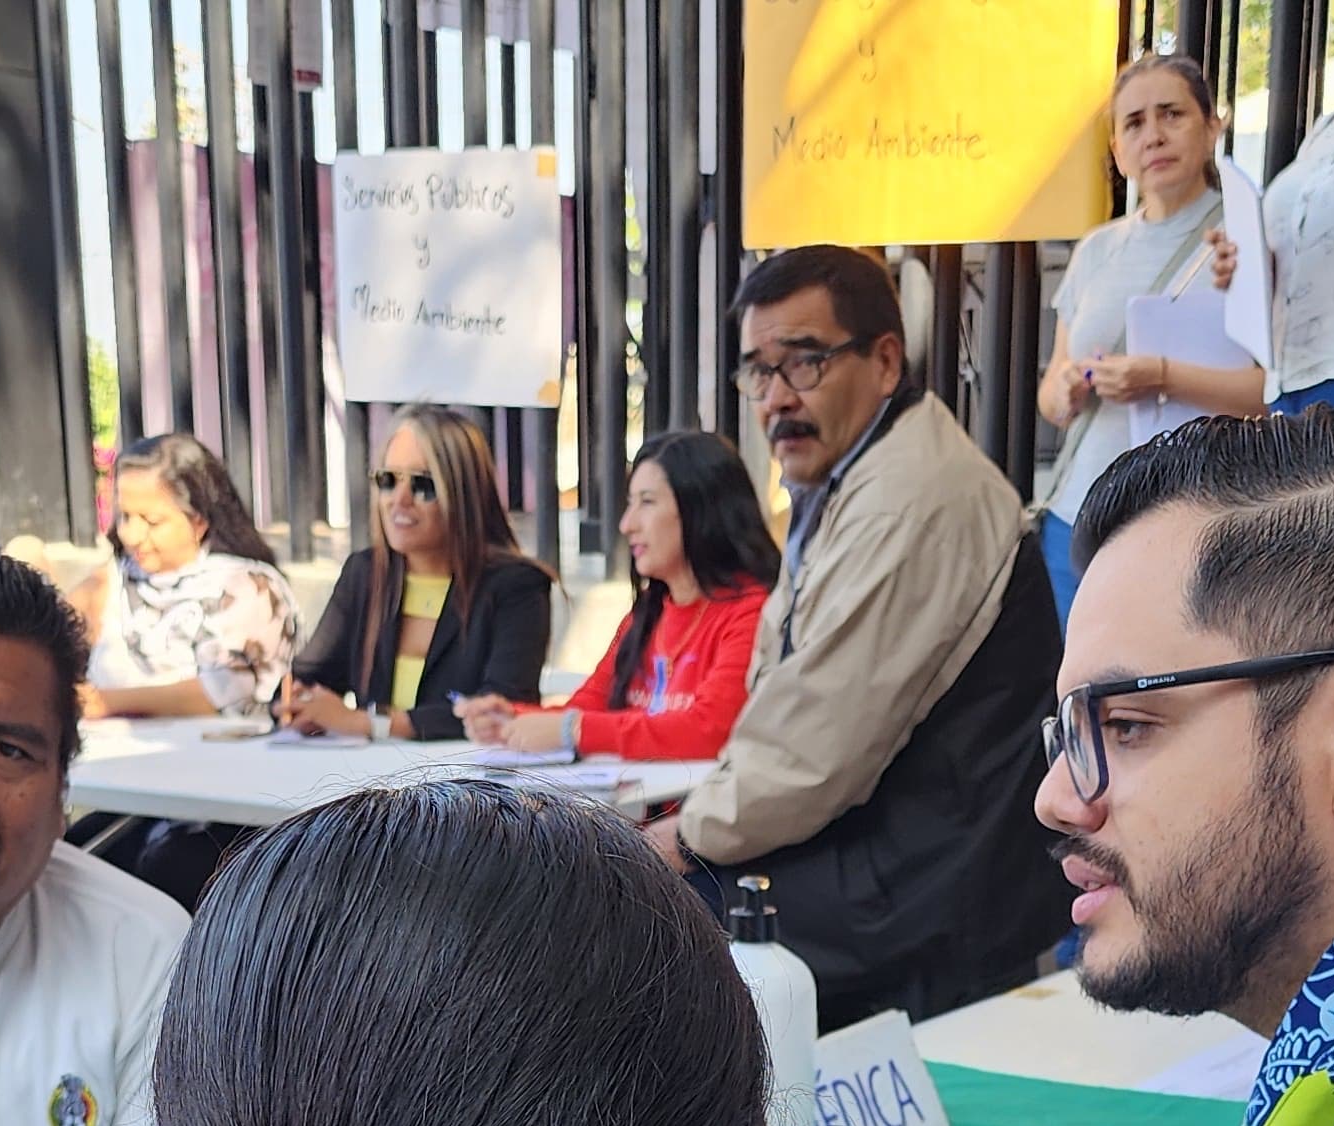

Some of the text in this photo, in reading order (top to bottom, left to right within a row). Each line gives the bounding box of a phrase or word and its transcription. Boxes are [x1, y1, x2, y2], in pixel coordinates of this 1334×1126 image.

[771, 112, 989, 162] Medio Ambiente
[351, 283, 507, 337] Medio Ambiente
